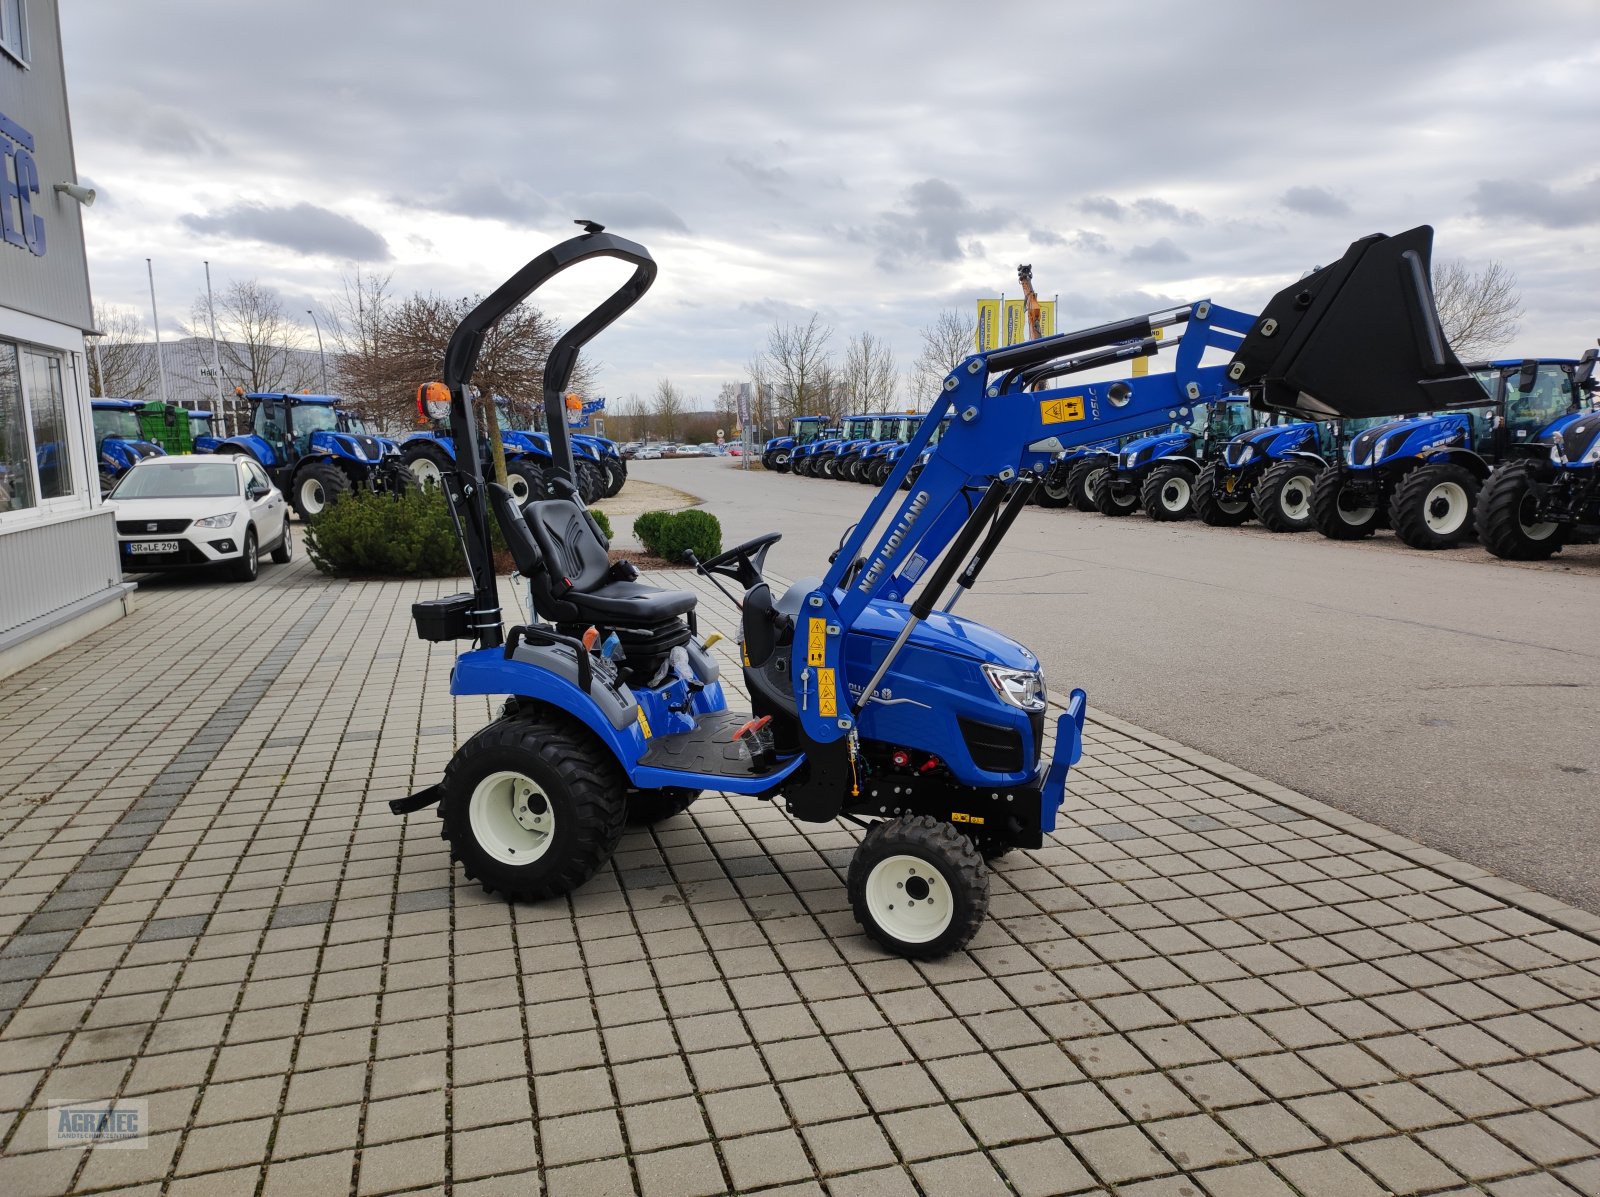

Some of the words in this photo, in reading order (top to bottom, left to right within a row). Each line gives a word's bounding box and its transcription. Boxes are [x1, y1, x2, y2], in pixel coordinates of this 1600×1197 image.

[161, 542, 178, 551] 296
[858, 557, 887, 595] NEW
[880, 490, 931, 559] HOLLAND
